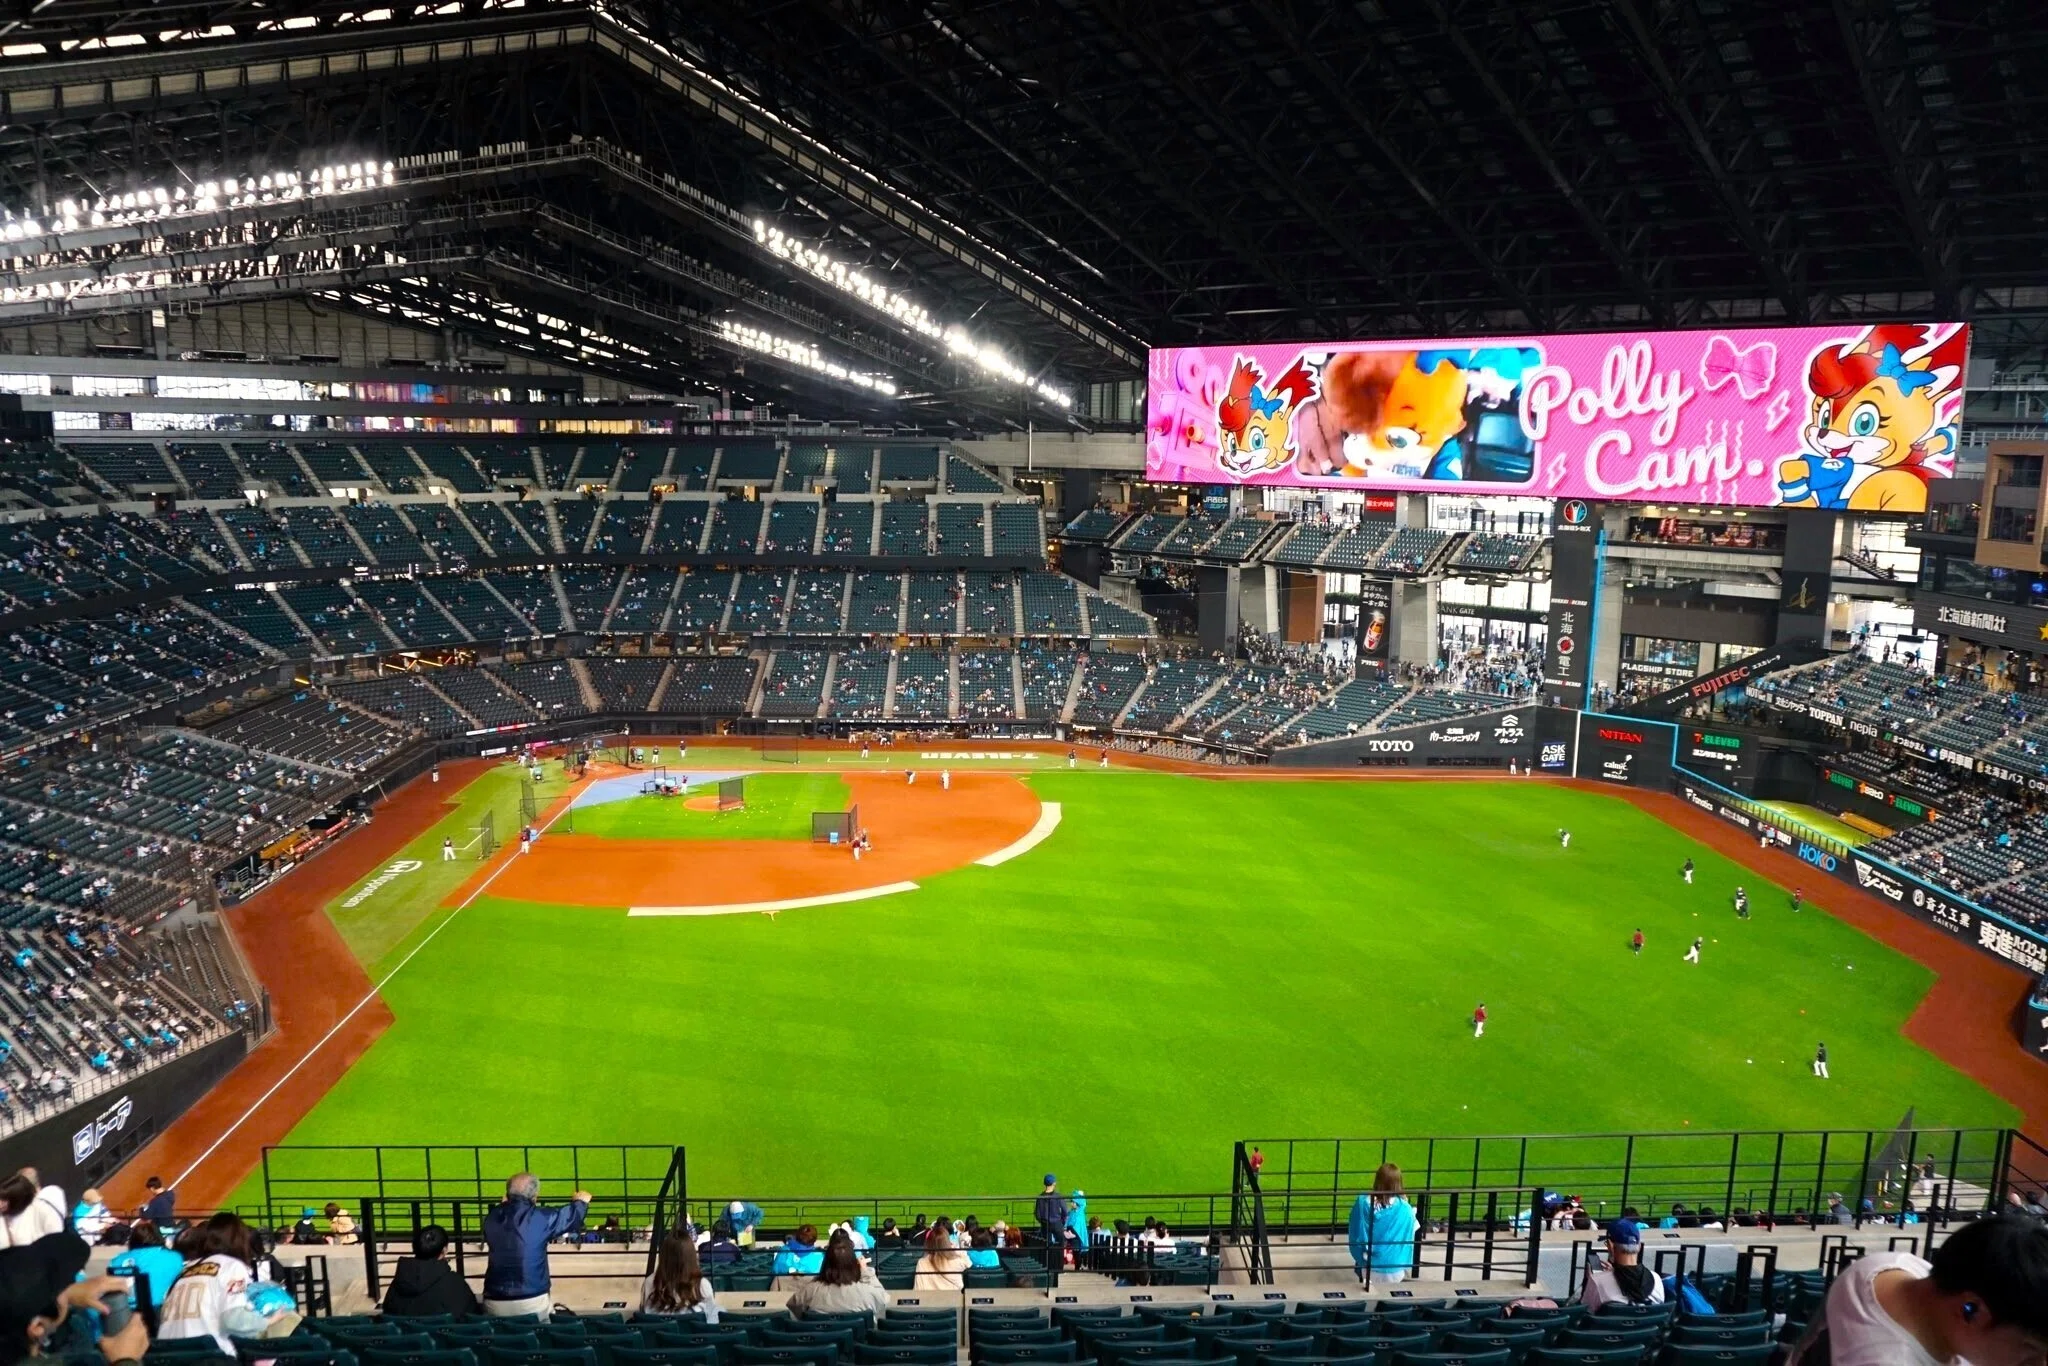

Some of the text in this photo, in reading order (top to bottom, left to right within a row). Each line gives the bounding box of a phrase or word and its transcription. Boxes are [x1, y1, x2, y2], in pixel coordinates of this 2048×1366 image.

[1519, 340, 1695, 446] Polly
[1585, 430, 1764, 496] Cam.
[1937, 606, 2007, 633] 北海道新聞社
[1621, 662, 1695, 678] FLAGSHIP STORE
[1691, 666, 1751, 697] FUJITEC
[1494, 727, 1524, 737] アトラス
[1600, 729, 1643, 743] NITTAN
[1850, 720, 1878, 737] nepia
[1369, 740, 1414, 752] TOTO
[1542, 744, 1566, 755] ASK
[1541, 753, 1566, 762] GATE
[1984, 764, 2025, 786] 北海道バス
[1692, 793, 1714, 811] Fanatics
[1932, 915, 1959, 933] SAIKYU
[1978, 920, 2048, 962] 東進 ハイスクール
